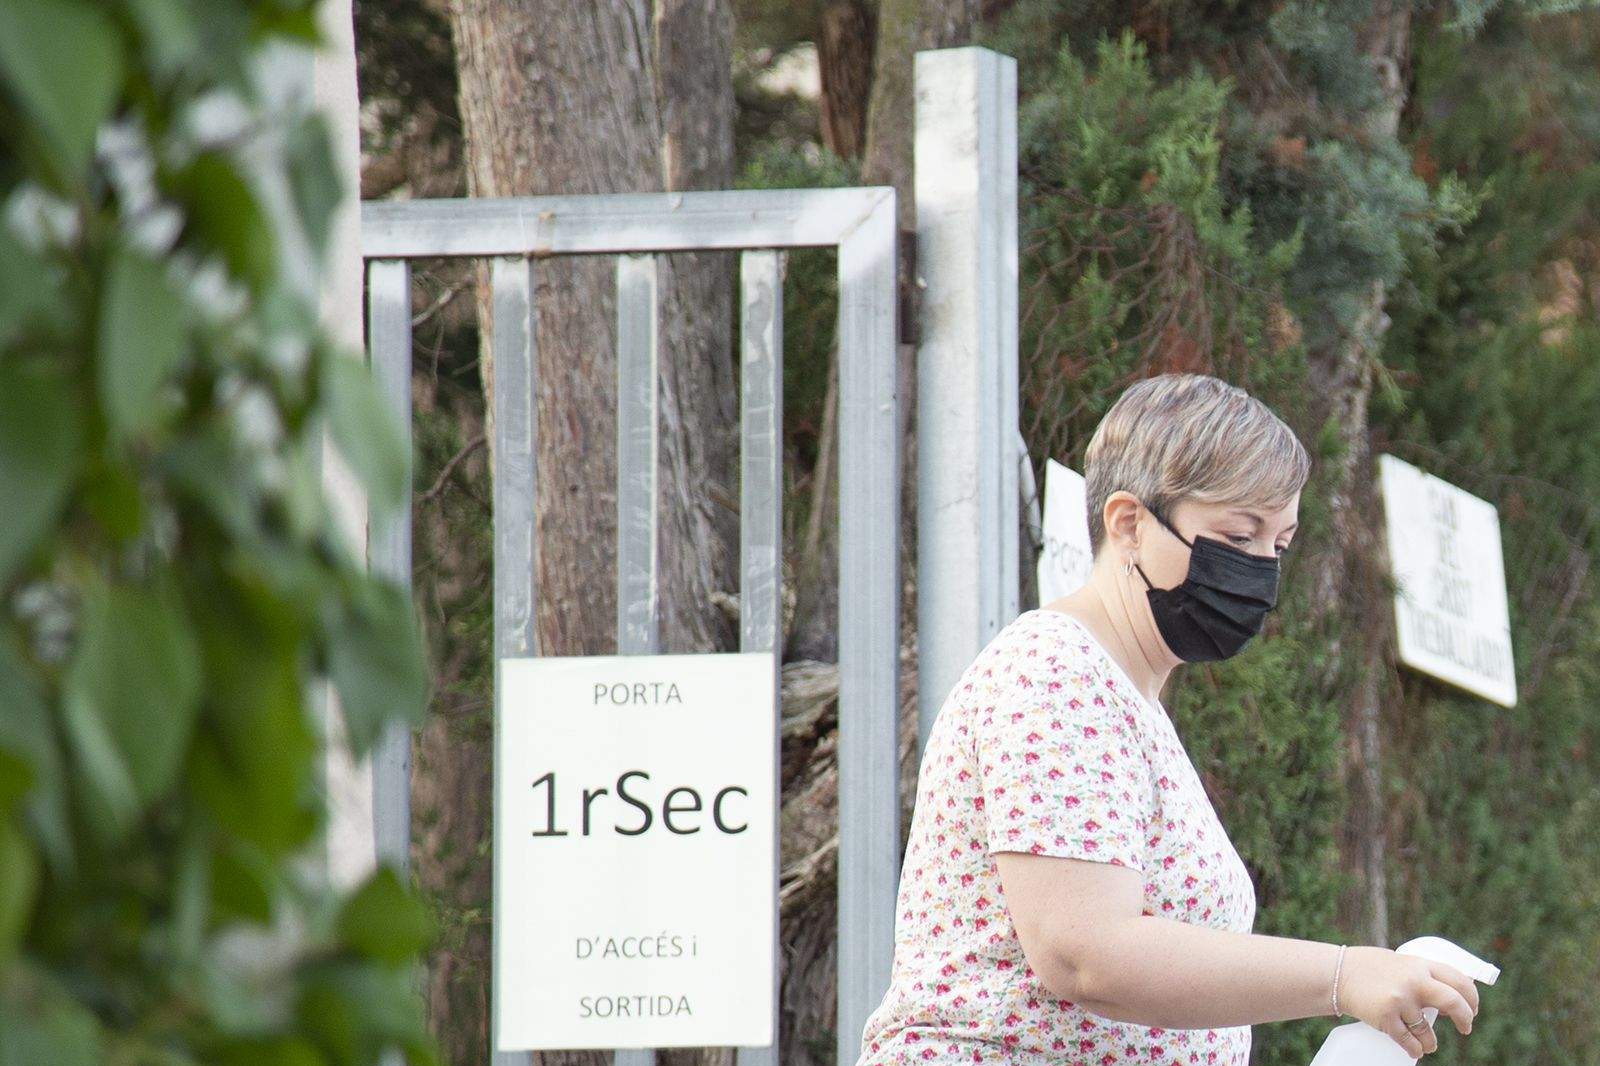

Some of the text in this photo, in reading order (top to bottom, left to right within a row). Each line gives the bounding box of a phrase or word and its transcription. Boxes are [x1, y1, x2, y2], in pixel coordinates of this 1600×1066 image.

[594, 682, 682, 706] PORTA
[531, 770, 749, 837] 1rSec
[576, 931, 683, 960] D'ACCÉS
[579, 995, 692, 1018] SORTIDA
